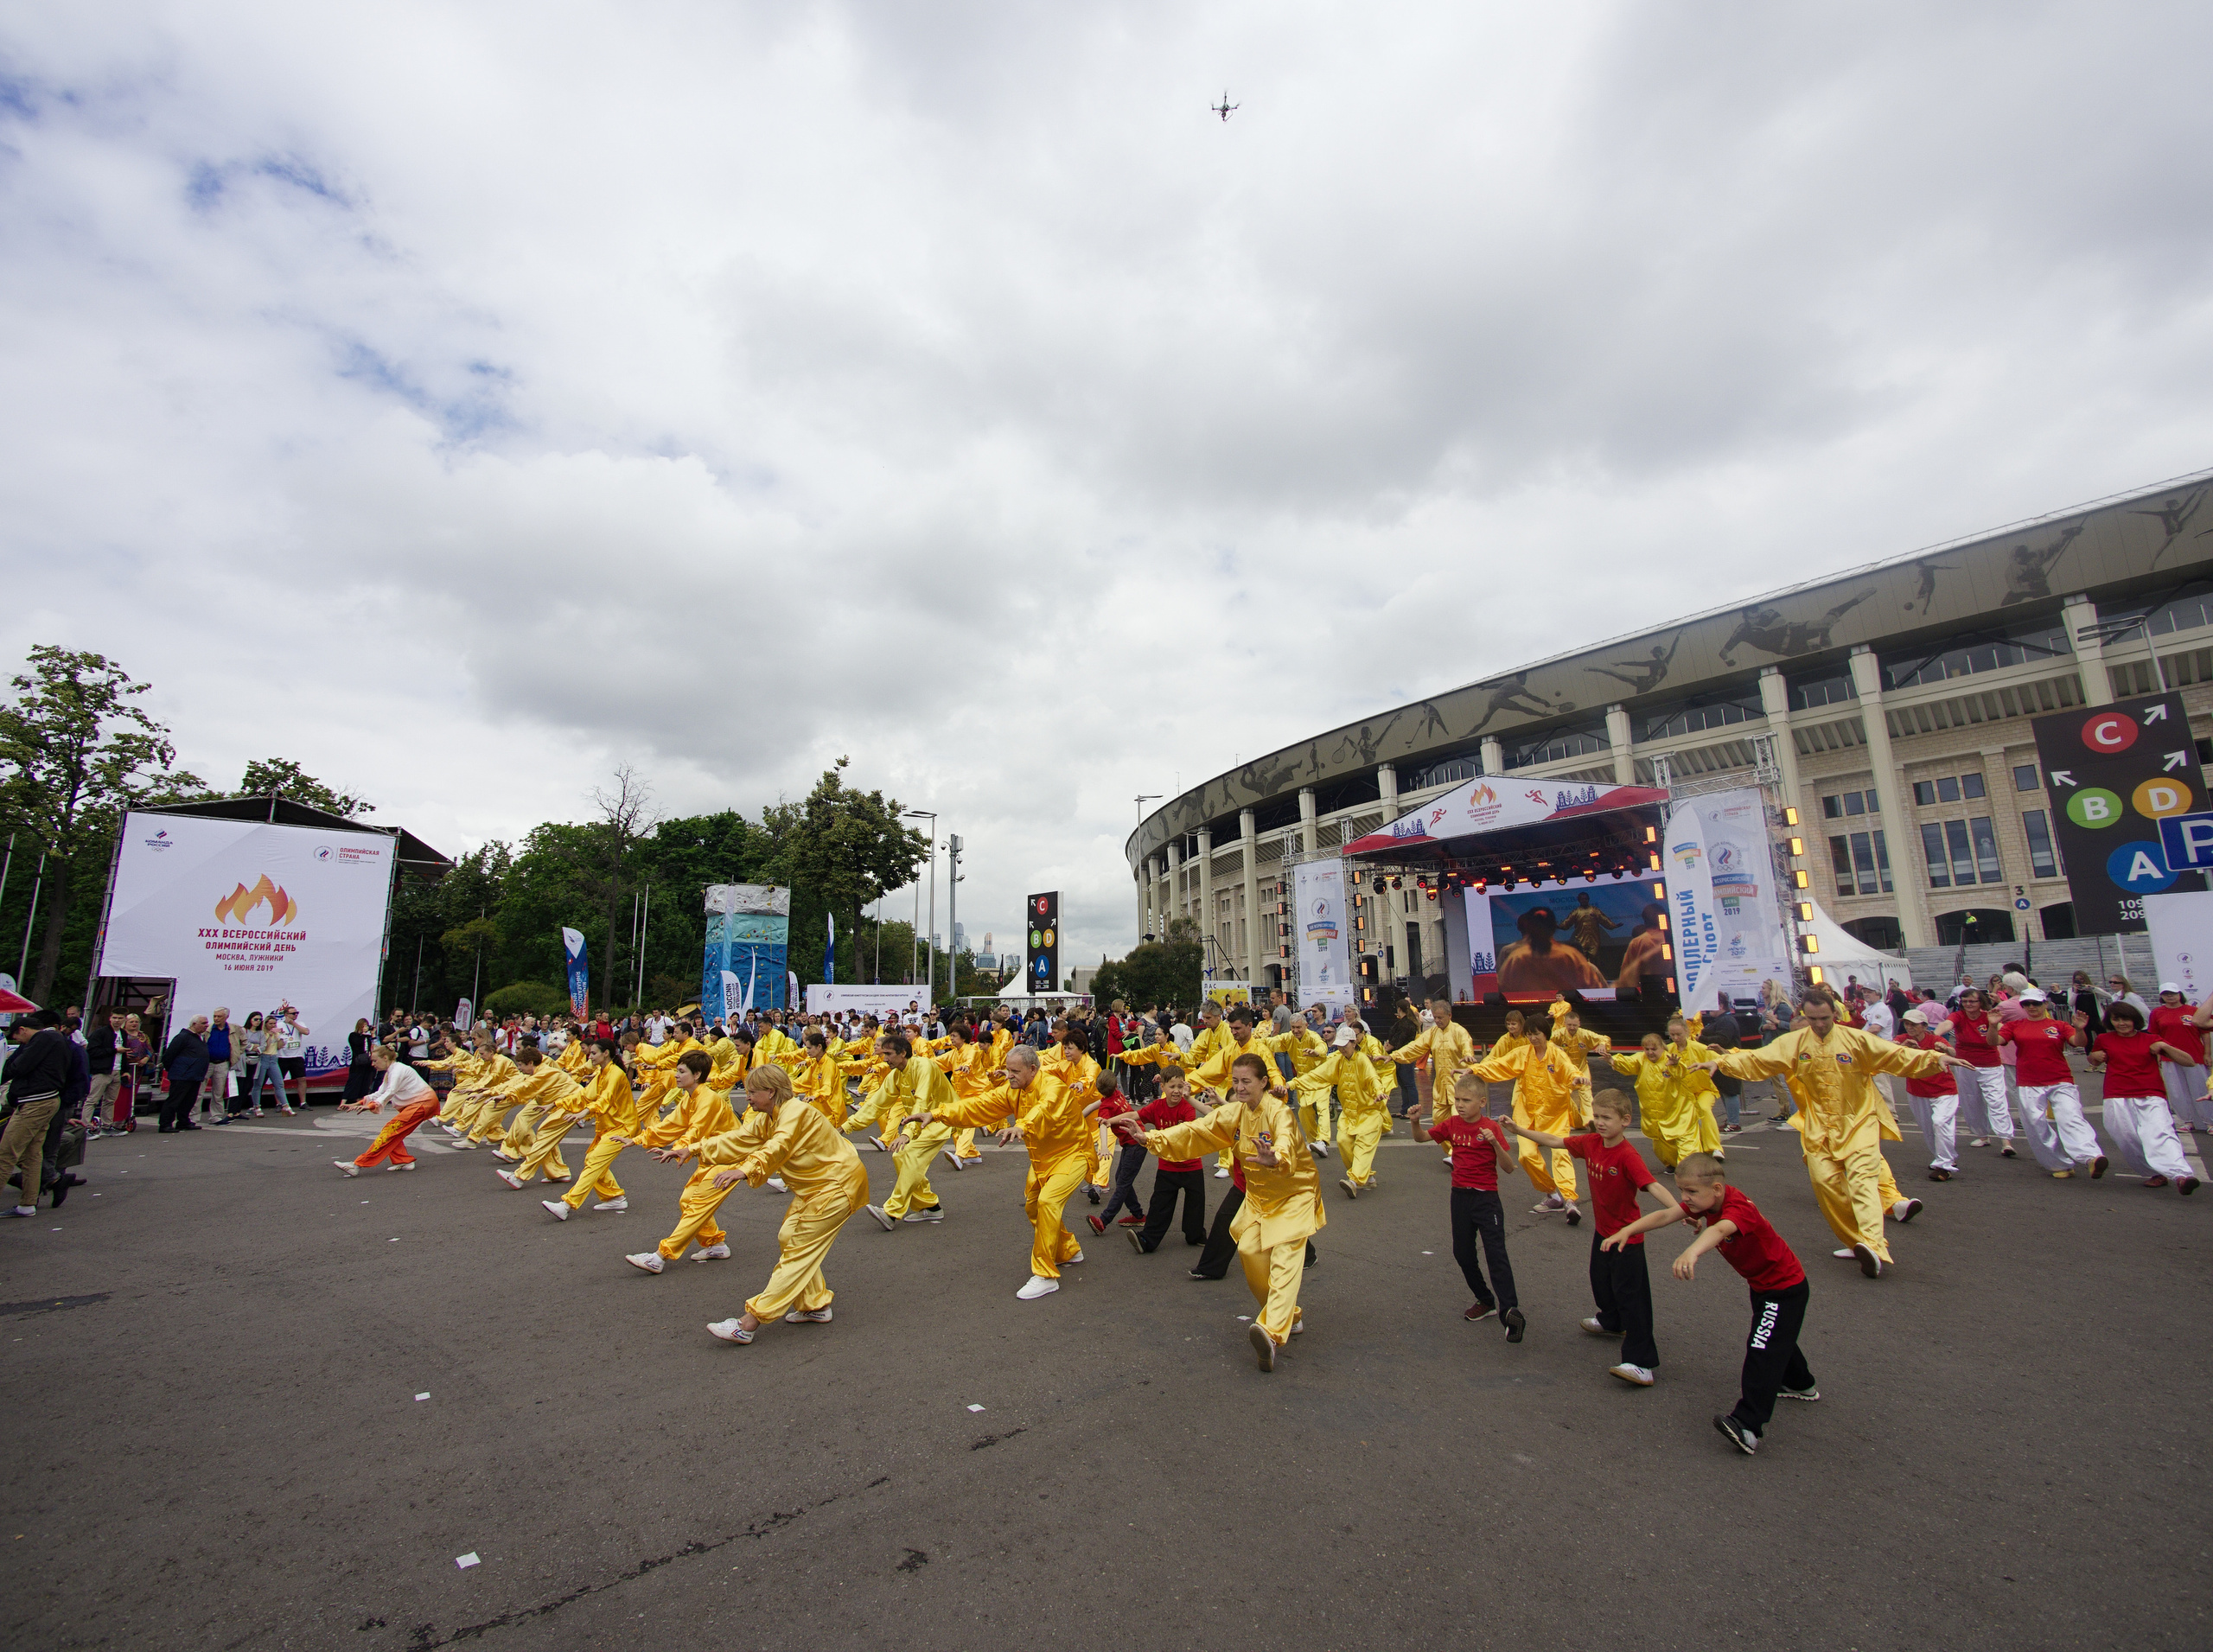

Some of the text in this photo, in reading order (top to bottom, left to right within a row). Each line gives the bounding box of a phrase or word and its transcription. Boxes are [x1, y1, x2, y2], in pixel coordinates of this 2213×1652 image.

[2095, 721, 2122, 745] C
[2082, 787, 2178, 821] B D
[2180, 819, 2213, 863] P
[340, 847, 380, 856] ОЛИМПИЙСКАЯ
[2127, 851, 2165, 882] A
[2015, 886, 2025, 896] 3
[1039, 900, 1045, 911] C
[1724, 907, 1740, 915] 2019
[198, 928, 306, 941] XXX ВСЕРОССИЙСКИЙ
[1033, 933, 1052, 945] B D
[205, 941, 271, 951] ОЛИМПИЙСКИЙ
[1038, 959, 1046, 973] A
[1751, 1301, 1779, 1349] RUSSIA
